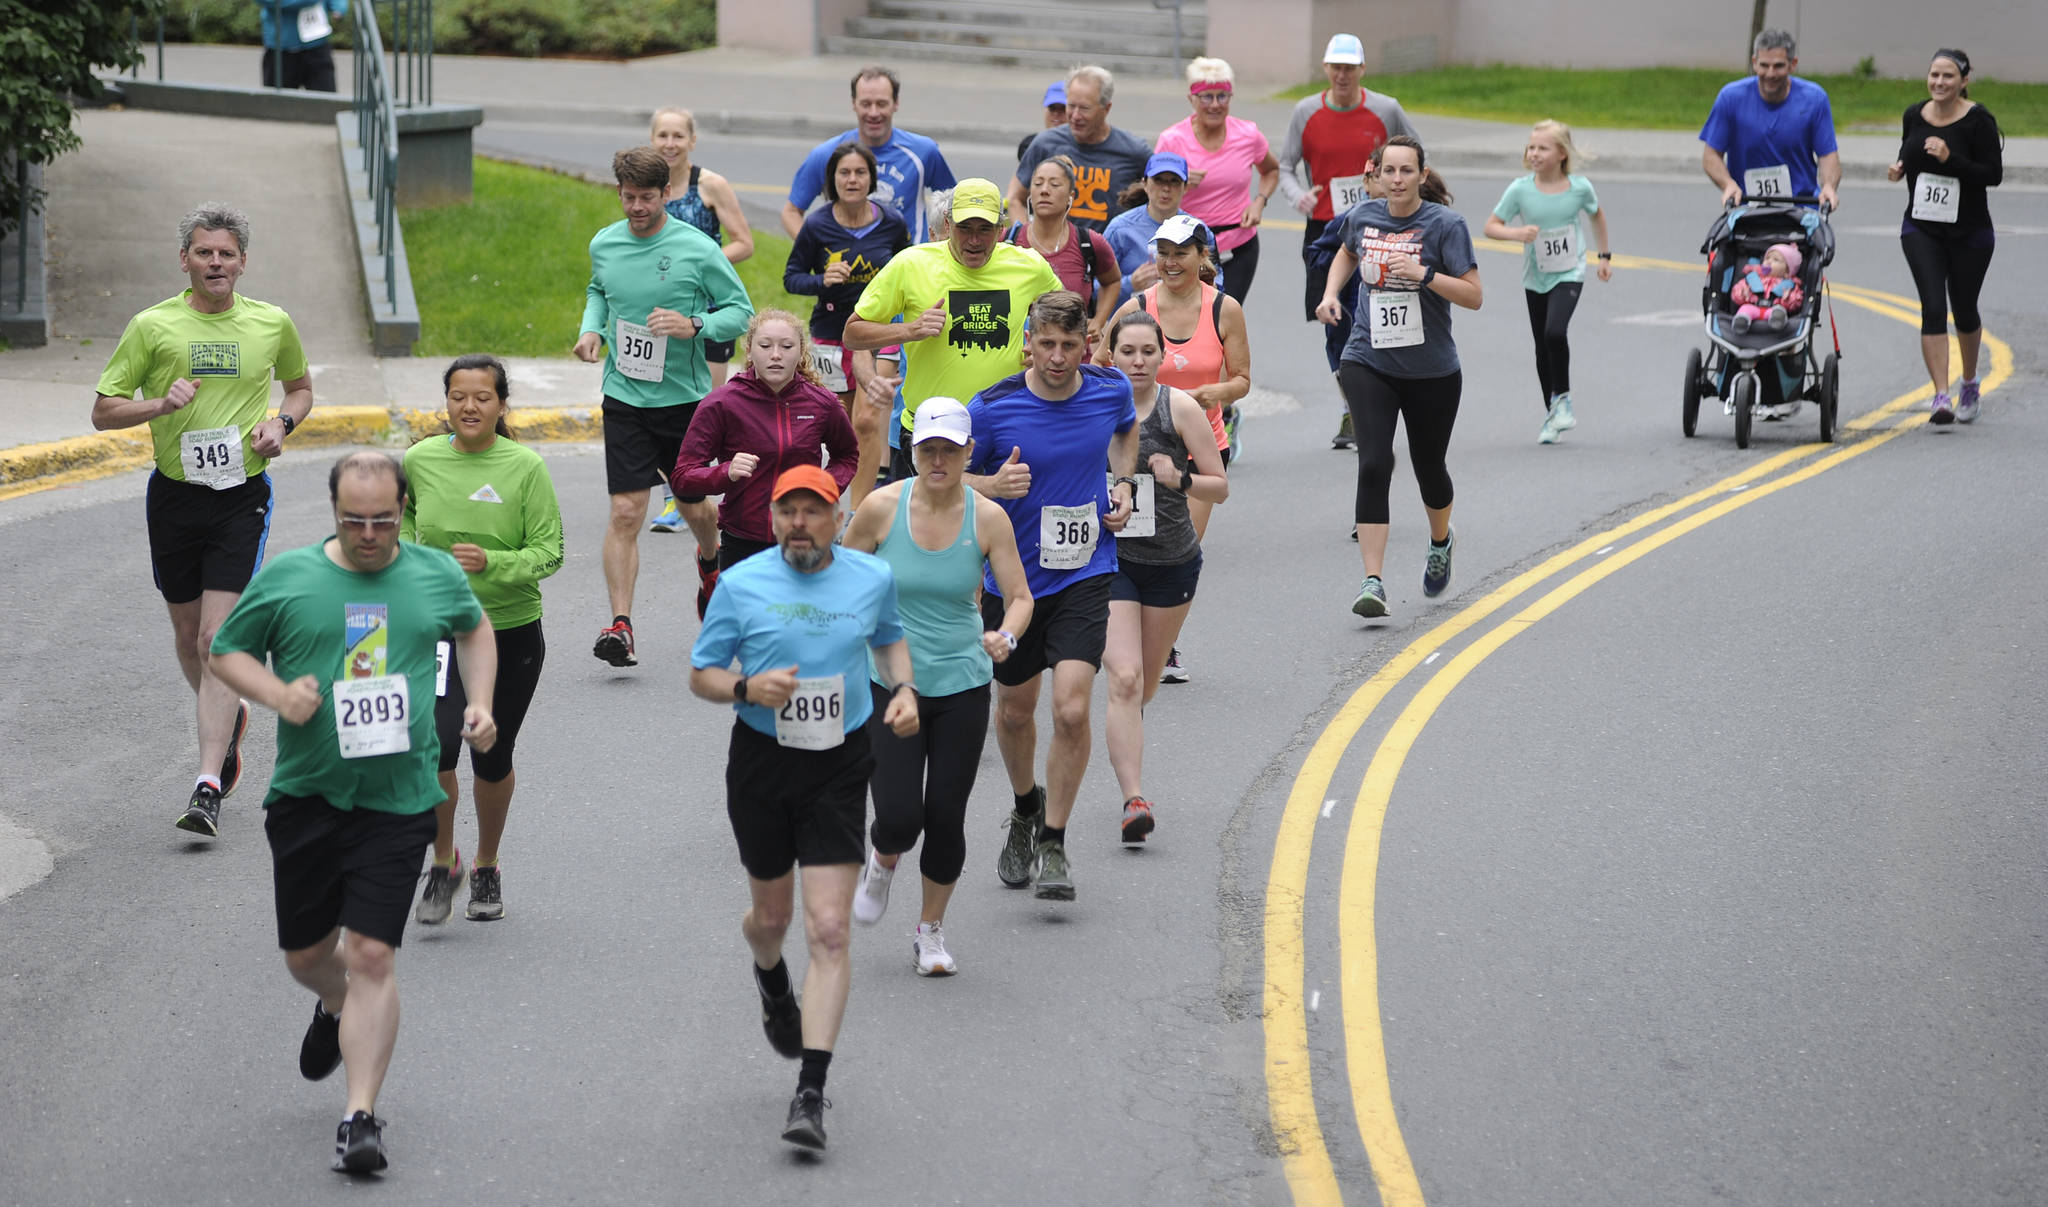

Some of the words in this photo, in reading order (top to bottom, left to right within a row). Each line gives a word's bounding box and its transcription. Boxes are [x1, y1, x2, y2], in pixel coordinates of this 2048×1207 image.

[1755, 179, 1781, 197] 361
[1924, 185, 1949, 205] 362
[1544, 237, 1568, 256] 364
[968, 305, 992, 314] BEAT
[971, 313, 990, 322] THE
[1380, 305, 1408, 327] 367
[963, 321, 998, 330] BRIDGE
[624, 335, 653, 360] 350
[193, 443, 230, 469] 349
[1056, 521, 1090, 545] 368
[341, 693, 405, 727] 2893
[780, 693, 840, 721] 2896
